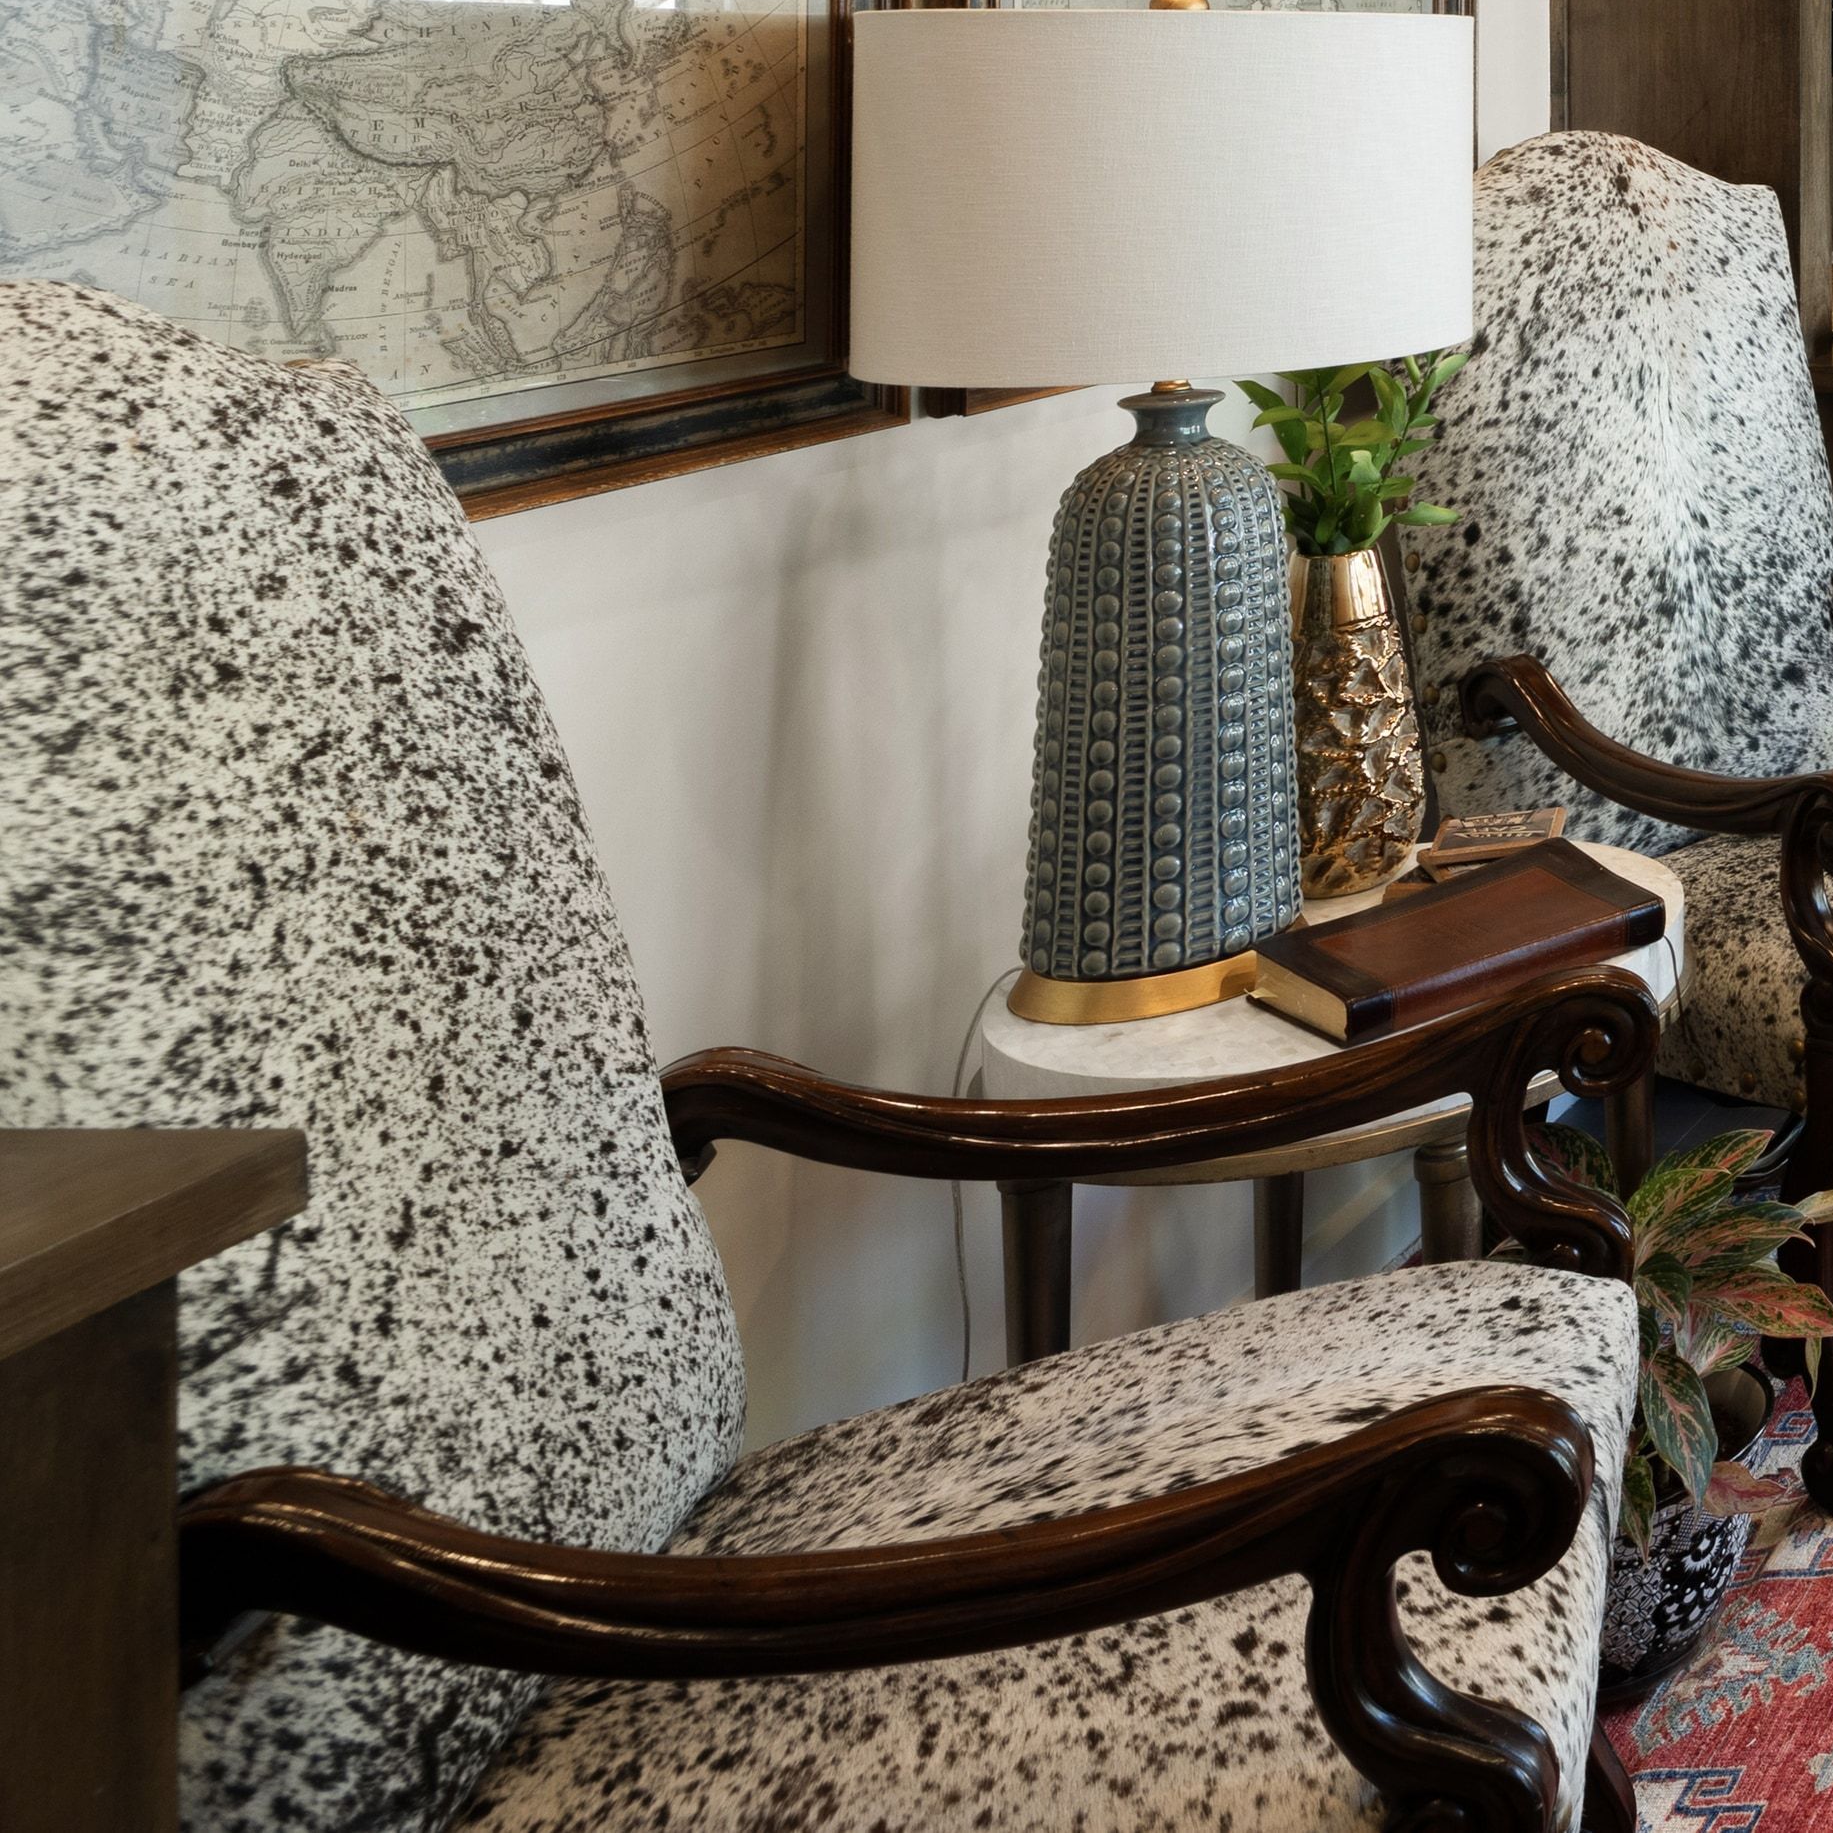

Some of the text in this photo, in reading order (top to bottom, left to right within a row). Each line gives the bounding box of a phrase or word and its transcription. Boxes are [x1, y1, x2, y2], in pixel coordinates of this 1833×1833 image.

[285, 227, 362, 239] INDIA
[221, 238, 258, 251] Bombay
[119, 246, 239, 268] ARABIAN
[276, 250, 323, 261] Hyderabad
[148, 275, 195, 290] SEA
[327, 284, 358, 294] Madras
